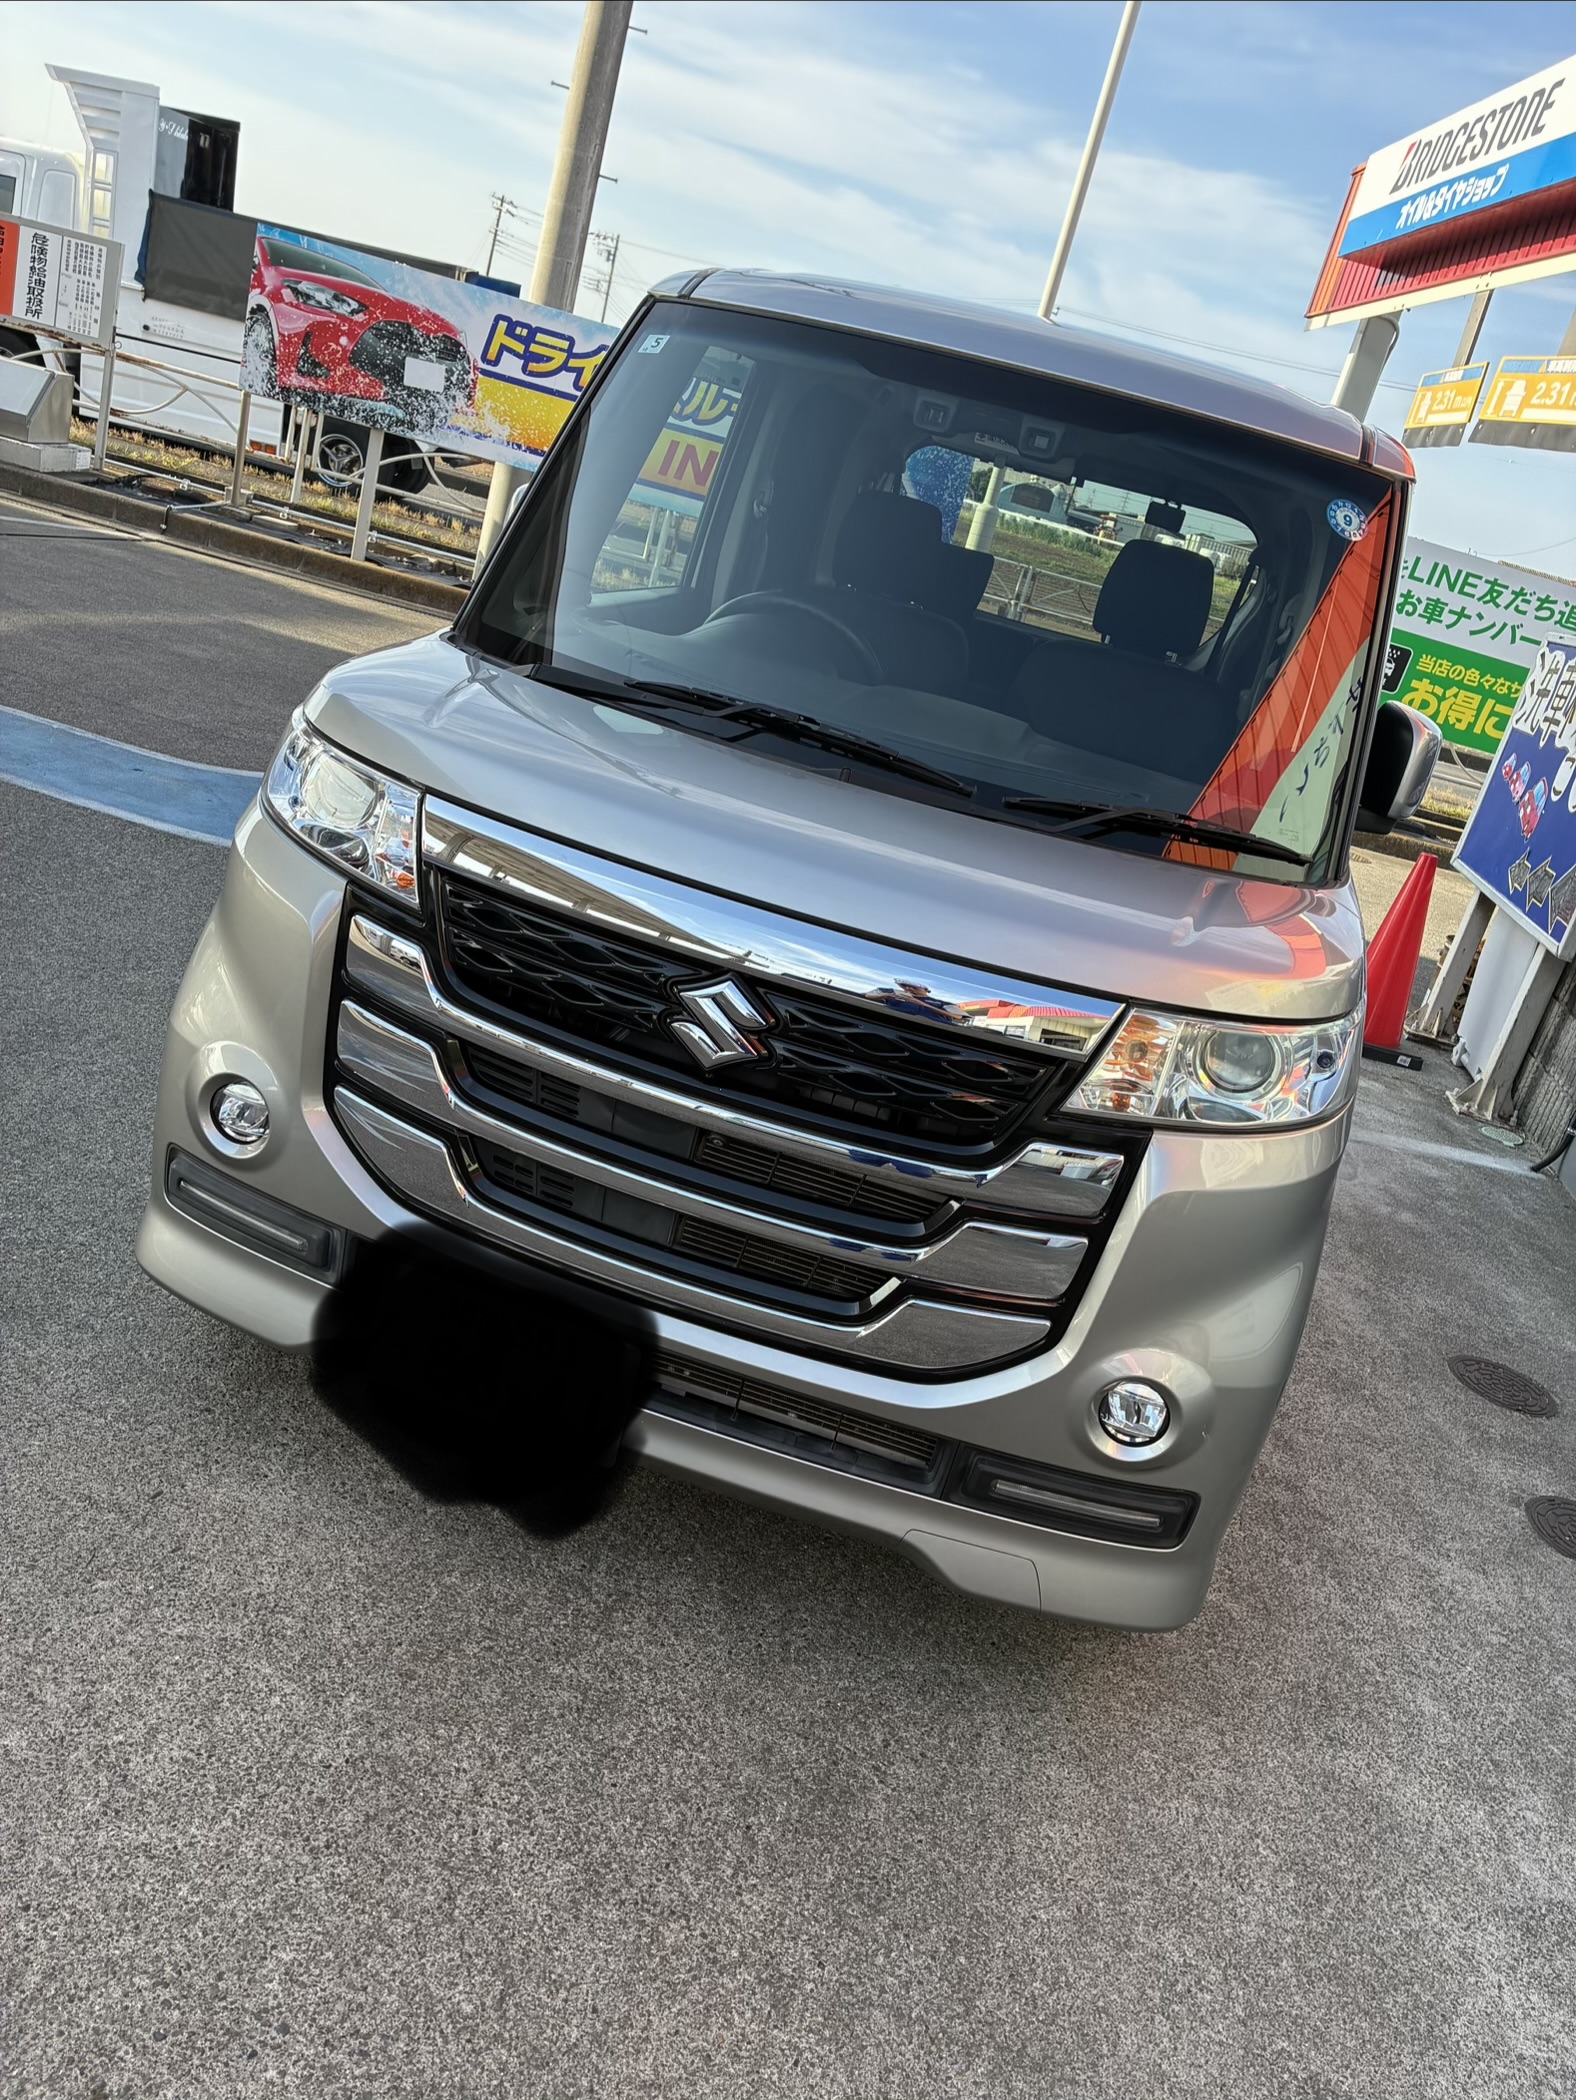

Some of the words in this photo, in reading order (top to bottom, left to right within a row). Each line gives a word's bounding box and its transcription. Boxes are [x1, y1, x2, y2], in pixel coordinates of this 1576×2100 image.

[1389, 77, 1566, 195] BRIDGESTONE
[25, 232, 49, 320] 危険物給油取扱所
[483, 316, 608, 390] ドライ
[651, 337, 664, 349] 5
[658, 440, 720, 487] IN
[1343, 513, 1353, 527] 9
[1395, 588, 1542, 647] お車ナンバー
[1402, 556, 1576, 632] LINE友だち追
[1401, 678, 1515, 740] お得に
